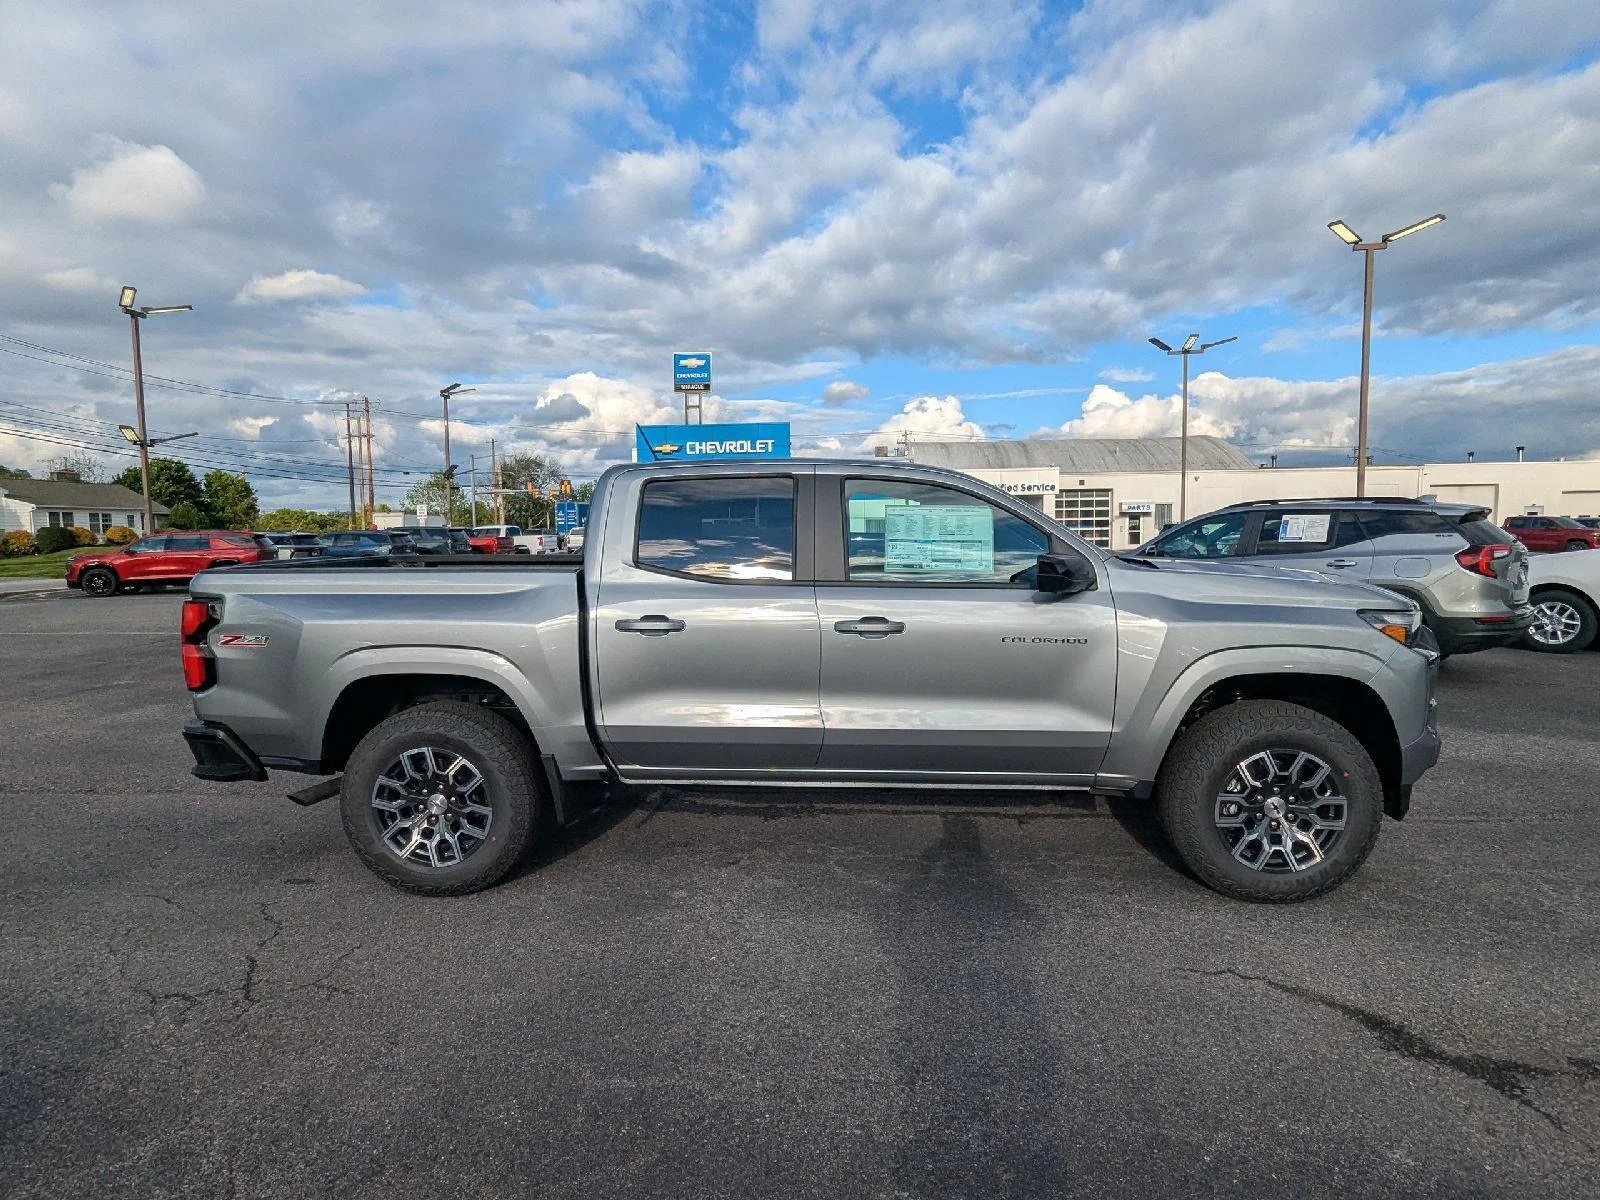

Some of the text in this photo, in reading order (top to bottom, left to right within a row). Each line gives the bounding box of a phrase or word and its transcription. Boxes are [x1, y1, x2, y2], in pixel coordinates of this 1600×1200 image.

[686, 440, 775, 455] CHEVROLET
[1020, 483, 1056, 492] Service
[1001, 636, 1088, 645] COLORADO
